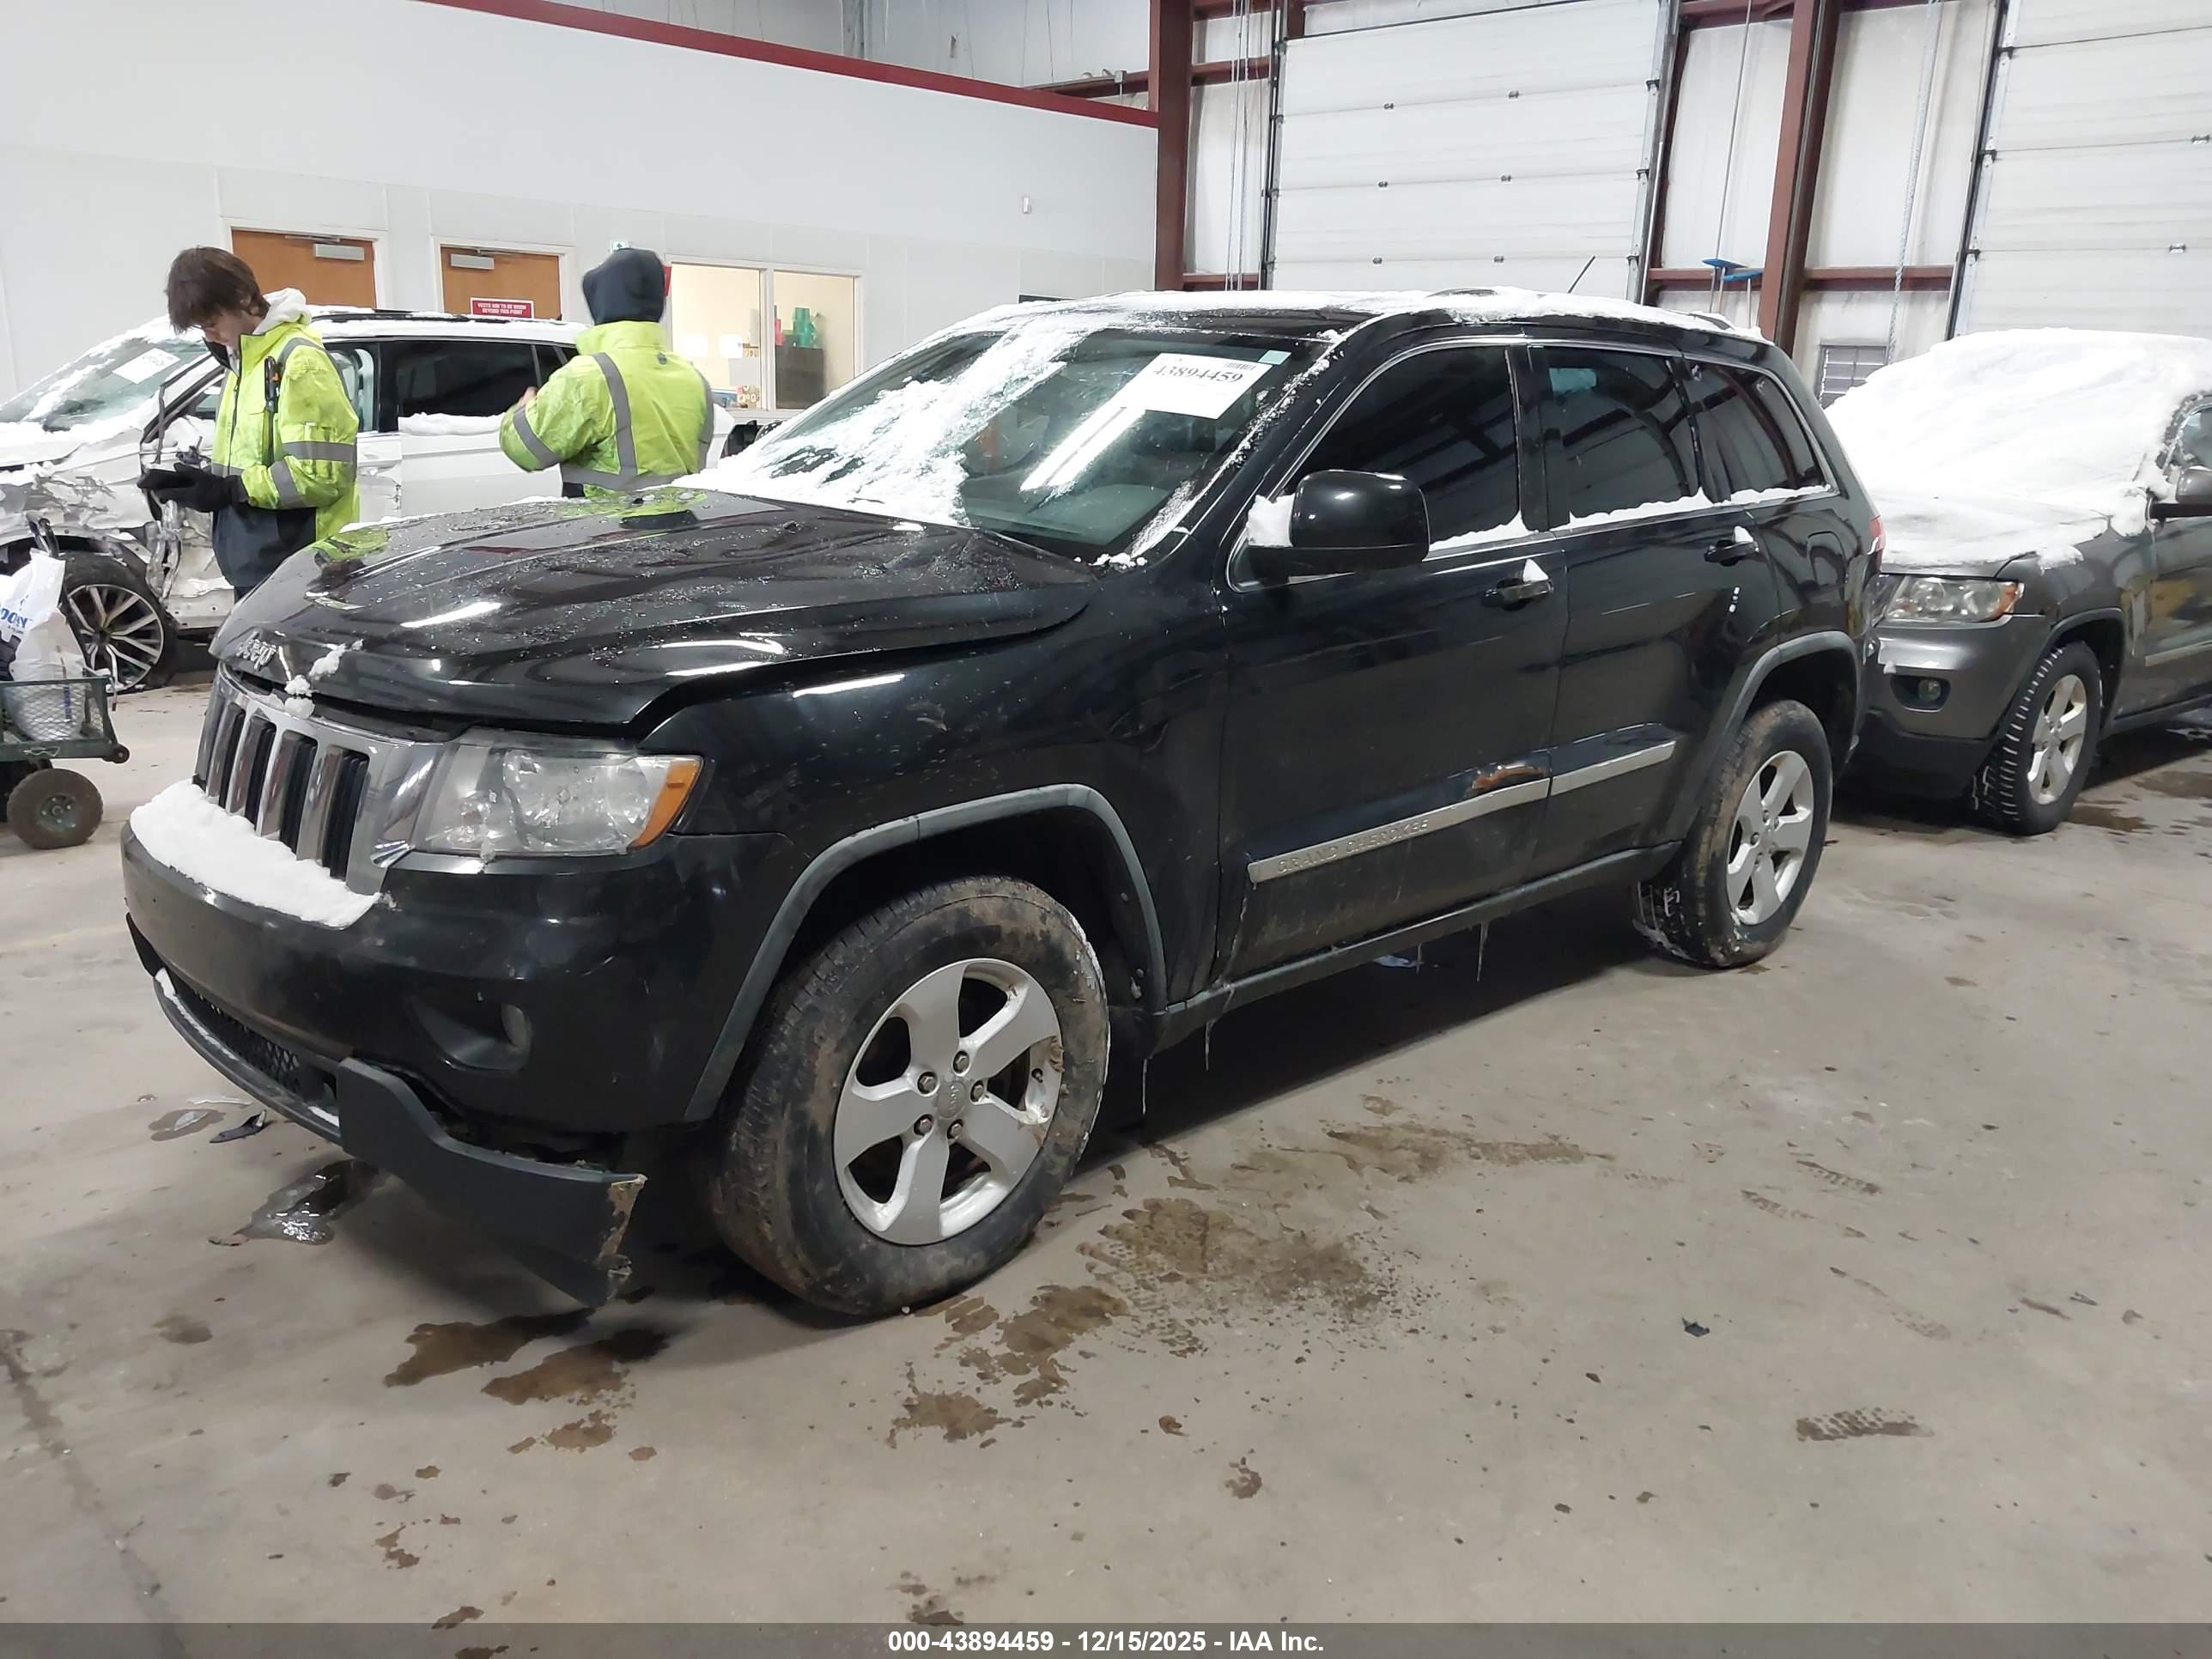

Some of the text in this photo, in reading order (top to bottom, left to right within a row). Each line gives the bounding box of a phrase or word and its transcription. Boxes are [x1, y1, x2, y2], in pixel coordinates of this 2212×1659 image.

[1153, 365, 1243, 383] 43894459
[235, 630, 276, 669] Jeep
[1278, 818, 1429, 873] GRAND CHEROKEE
